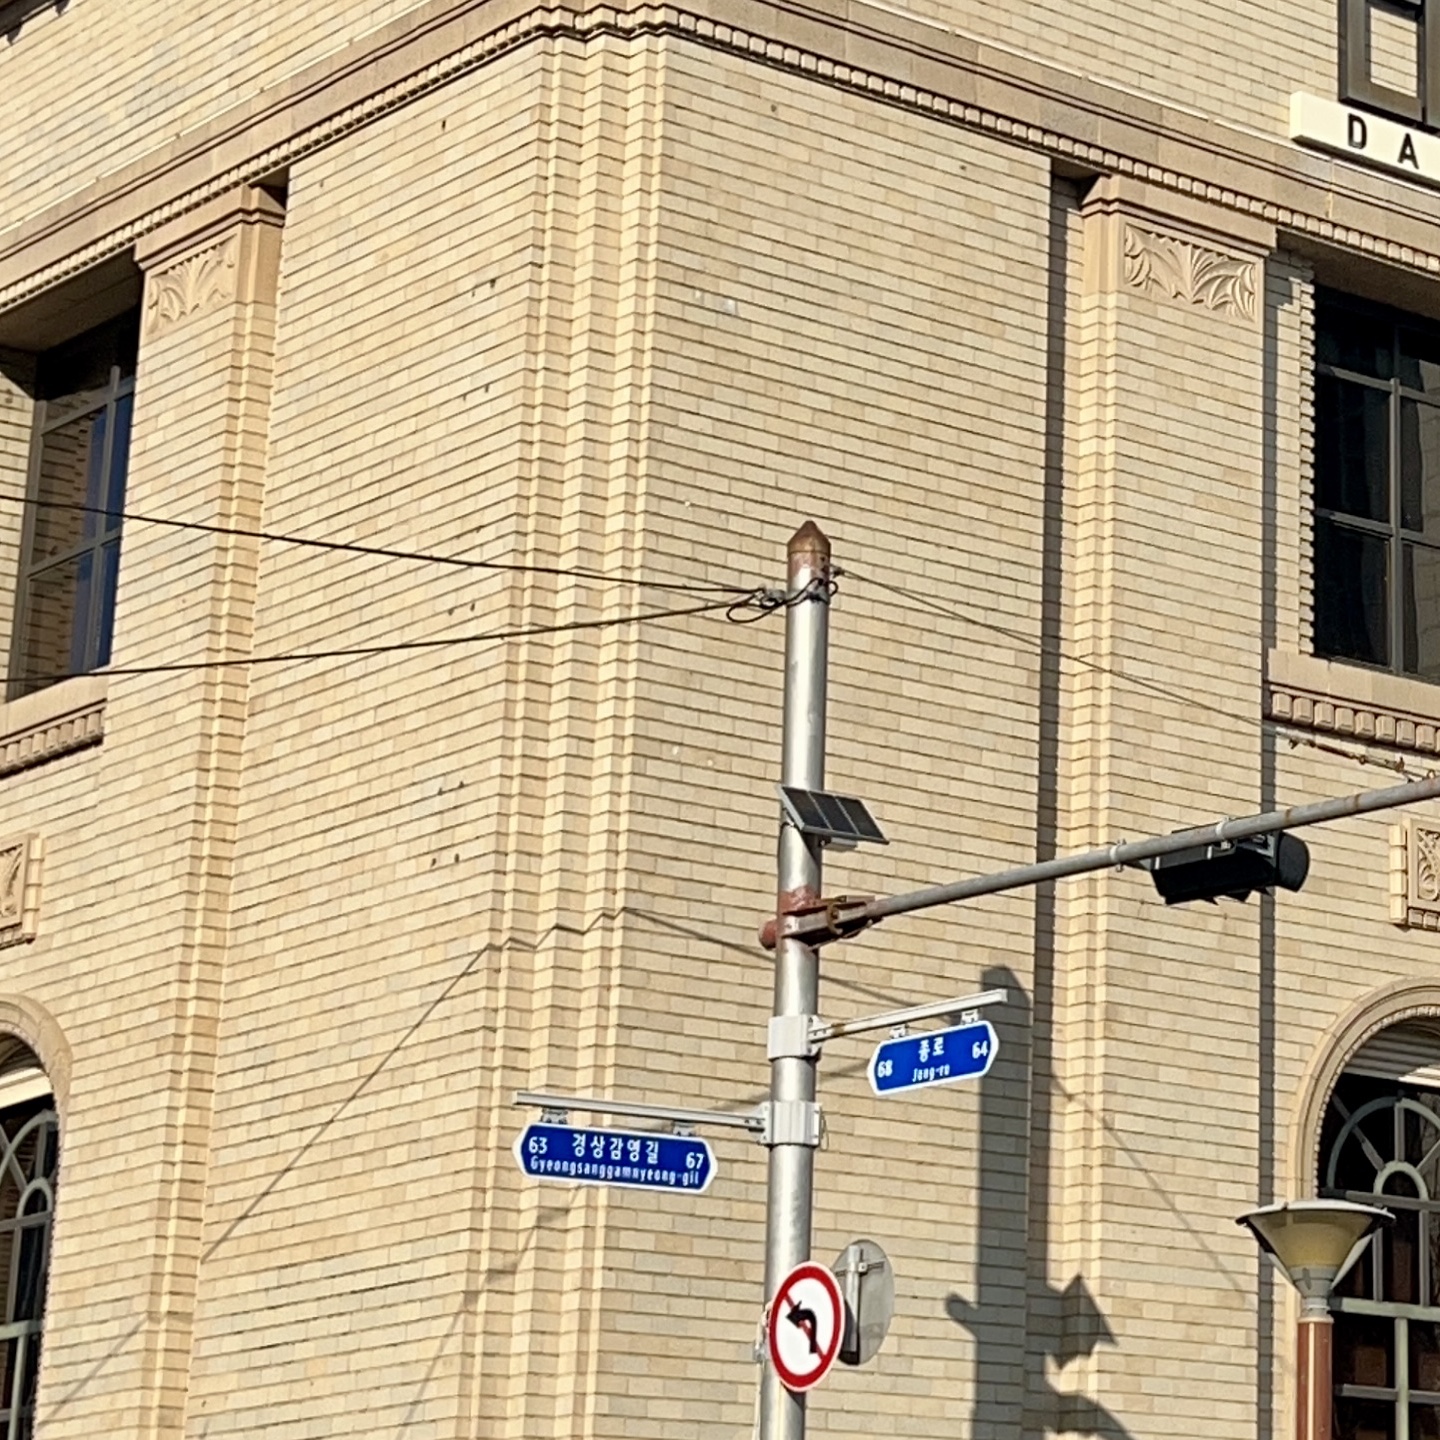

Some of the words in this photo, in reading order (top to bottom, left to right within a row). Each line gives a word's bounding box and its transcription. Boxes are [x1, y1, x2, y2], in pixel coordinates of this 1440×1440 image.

[877, 1059, 893, 1078] 68
[918, 1036, 945, 1063] 종로
[971, 1040, 989, 1059] 64
[528, 1136, 548, 1154] 63
[572, 1133, 659, 1165] 경상감영길
[685, 1152, 705, 1170] 67
[530, 1155, 700, 1186] Gyeongsanggamnyeong-gil
